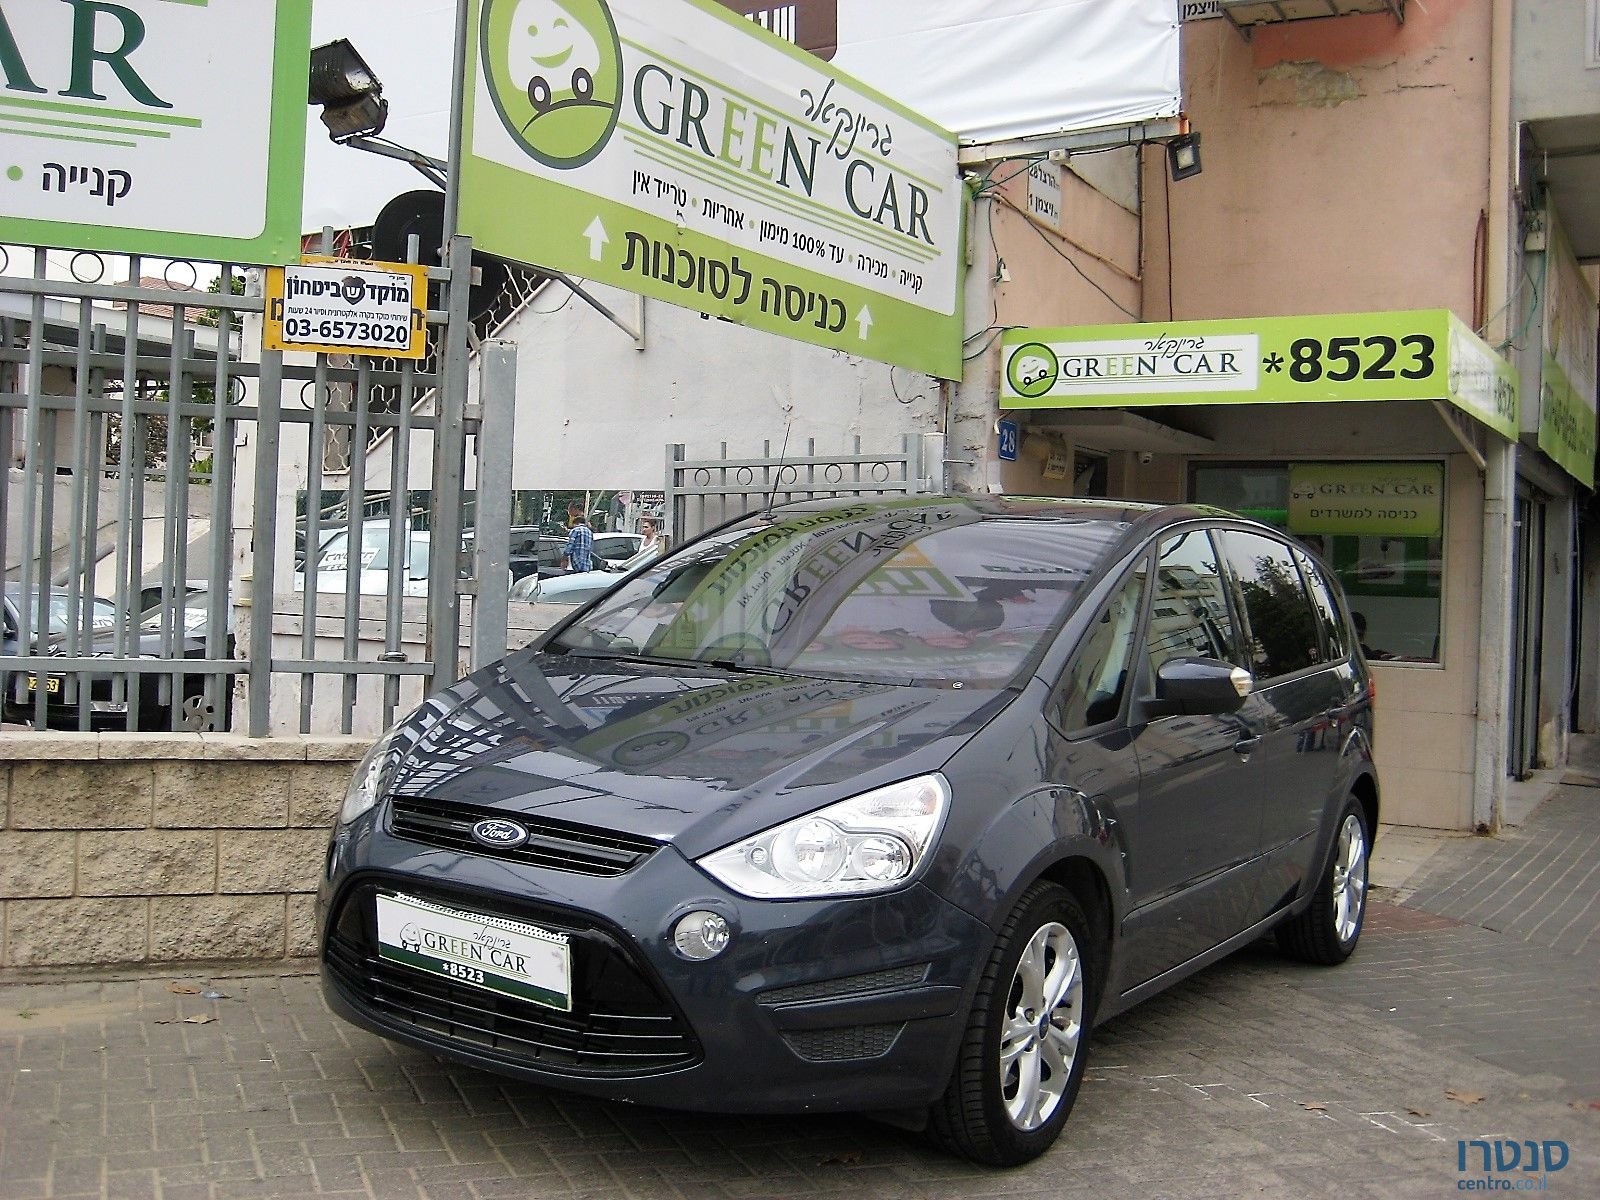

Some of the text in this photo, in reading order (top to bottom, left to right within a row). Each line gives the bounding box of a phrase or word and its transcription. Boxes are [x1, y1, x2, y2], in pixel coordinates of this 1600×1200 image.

[800, 78, 892, 160] גרינקאר
[633, 64, 934, 245] GREEN CAR
[42, 162, 132, 206] קנייה
[632, 170, 923, 294] קנייה מכירה עד 100% מימון אחריות טרייד אין
[287, 275, 341, 299] ביטחון
[366, 282, 409, 306] מוקד
[621, 231, 847, 333] כניסה לסוכנות
[305, 306, 313, 315] 24
[286, 318, 408, 343] 03-6573020
[1063, 353, 1240, 378] GREEN CAR
[1001, 428, 1016, 453] 28
[1394, 484, 1435, 495] CAR
[1378, 509, 1418, 519] כניסה
[481, 823, 514, 840] Ford
[424, 932, 527, 974] GREEN CAR
